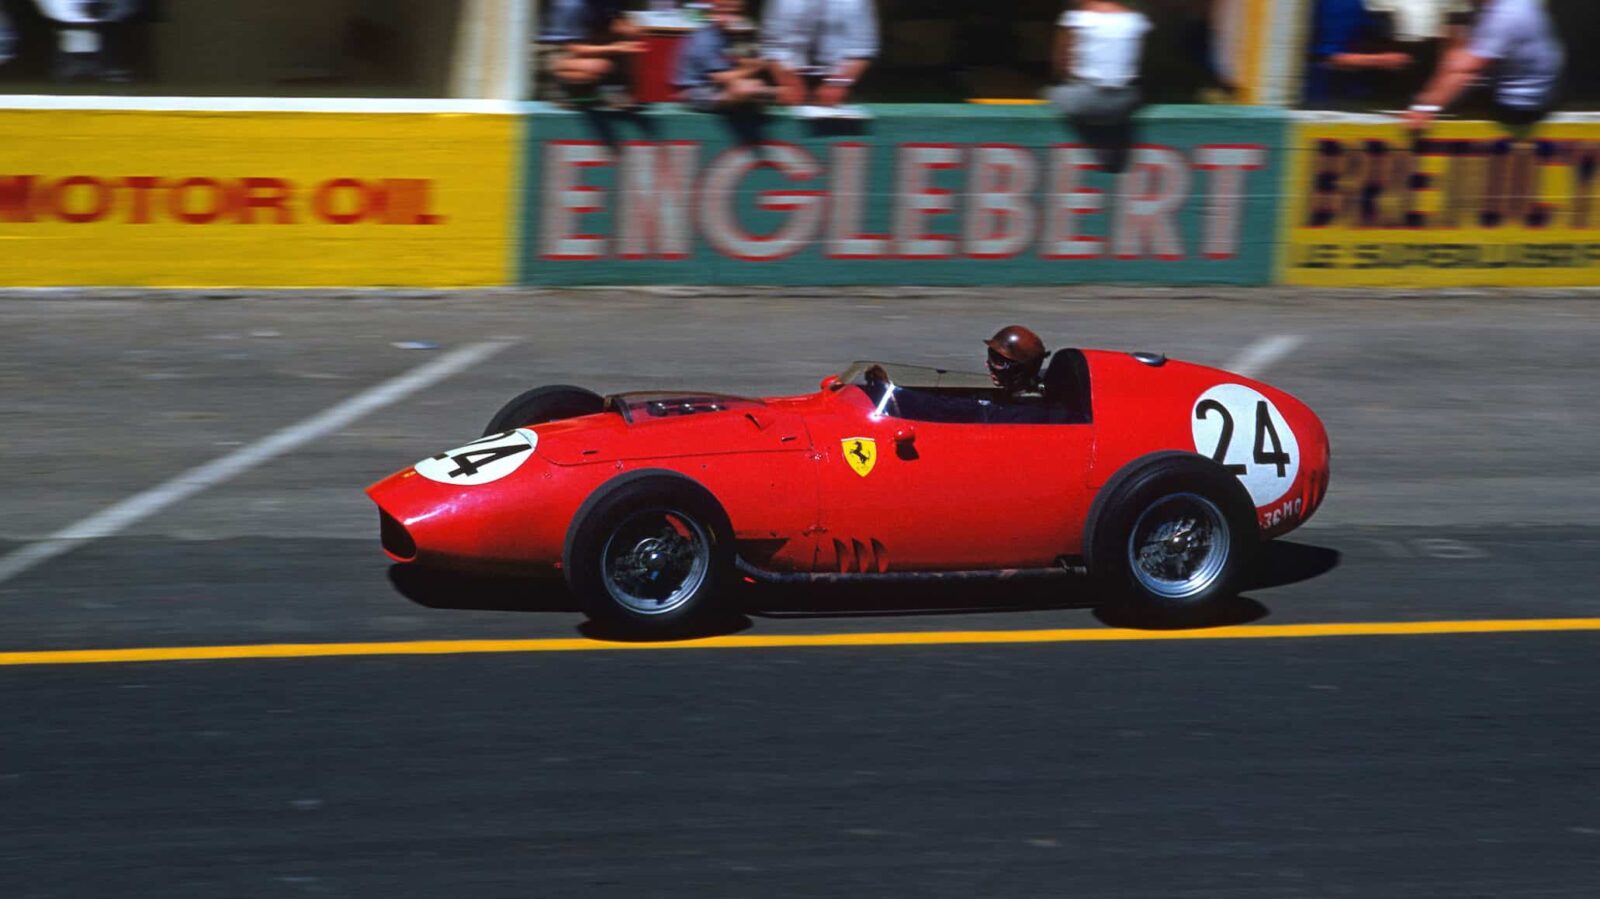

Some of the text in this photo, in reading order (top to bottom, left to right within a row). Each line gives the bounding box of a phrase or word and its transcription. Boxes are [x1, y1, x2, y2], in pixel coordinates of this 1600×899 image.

[0, 175, 445, 226] MOTOR OIL
[537, 138, 1268, 262] ENGLEBERT
[1195, 399, 1291, 477] 24
